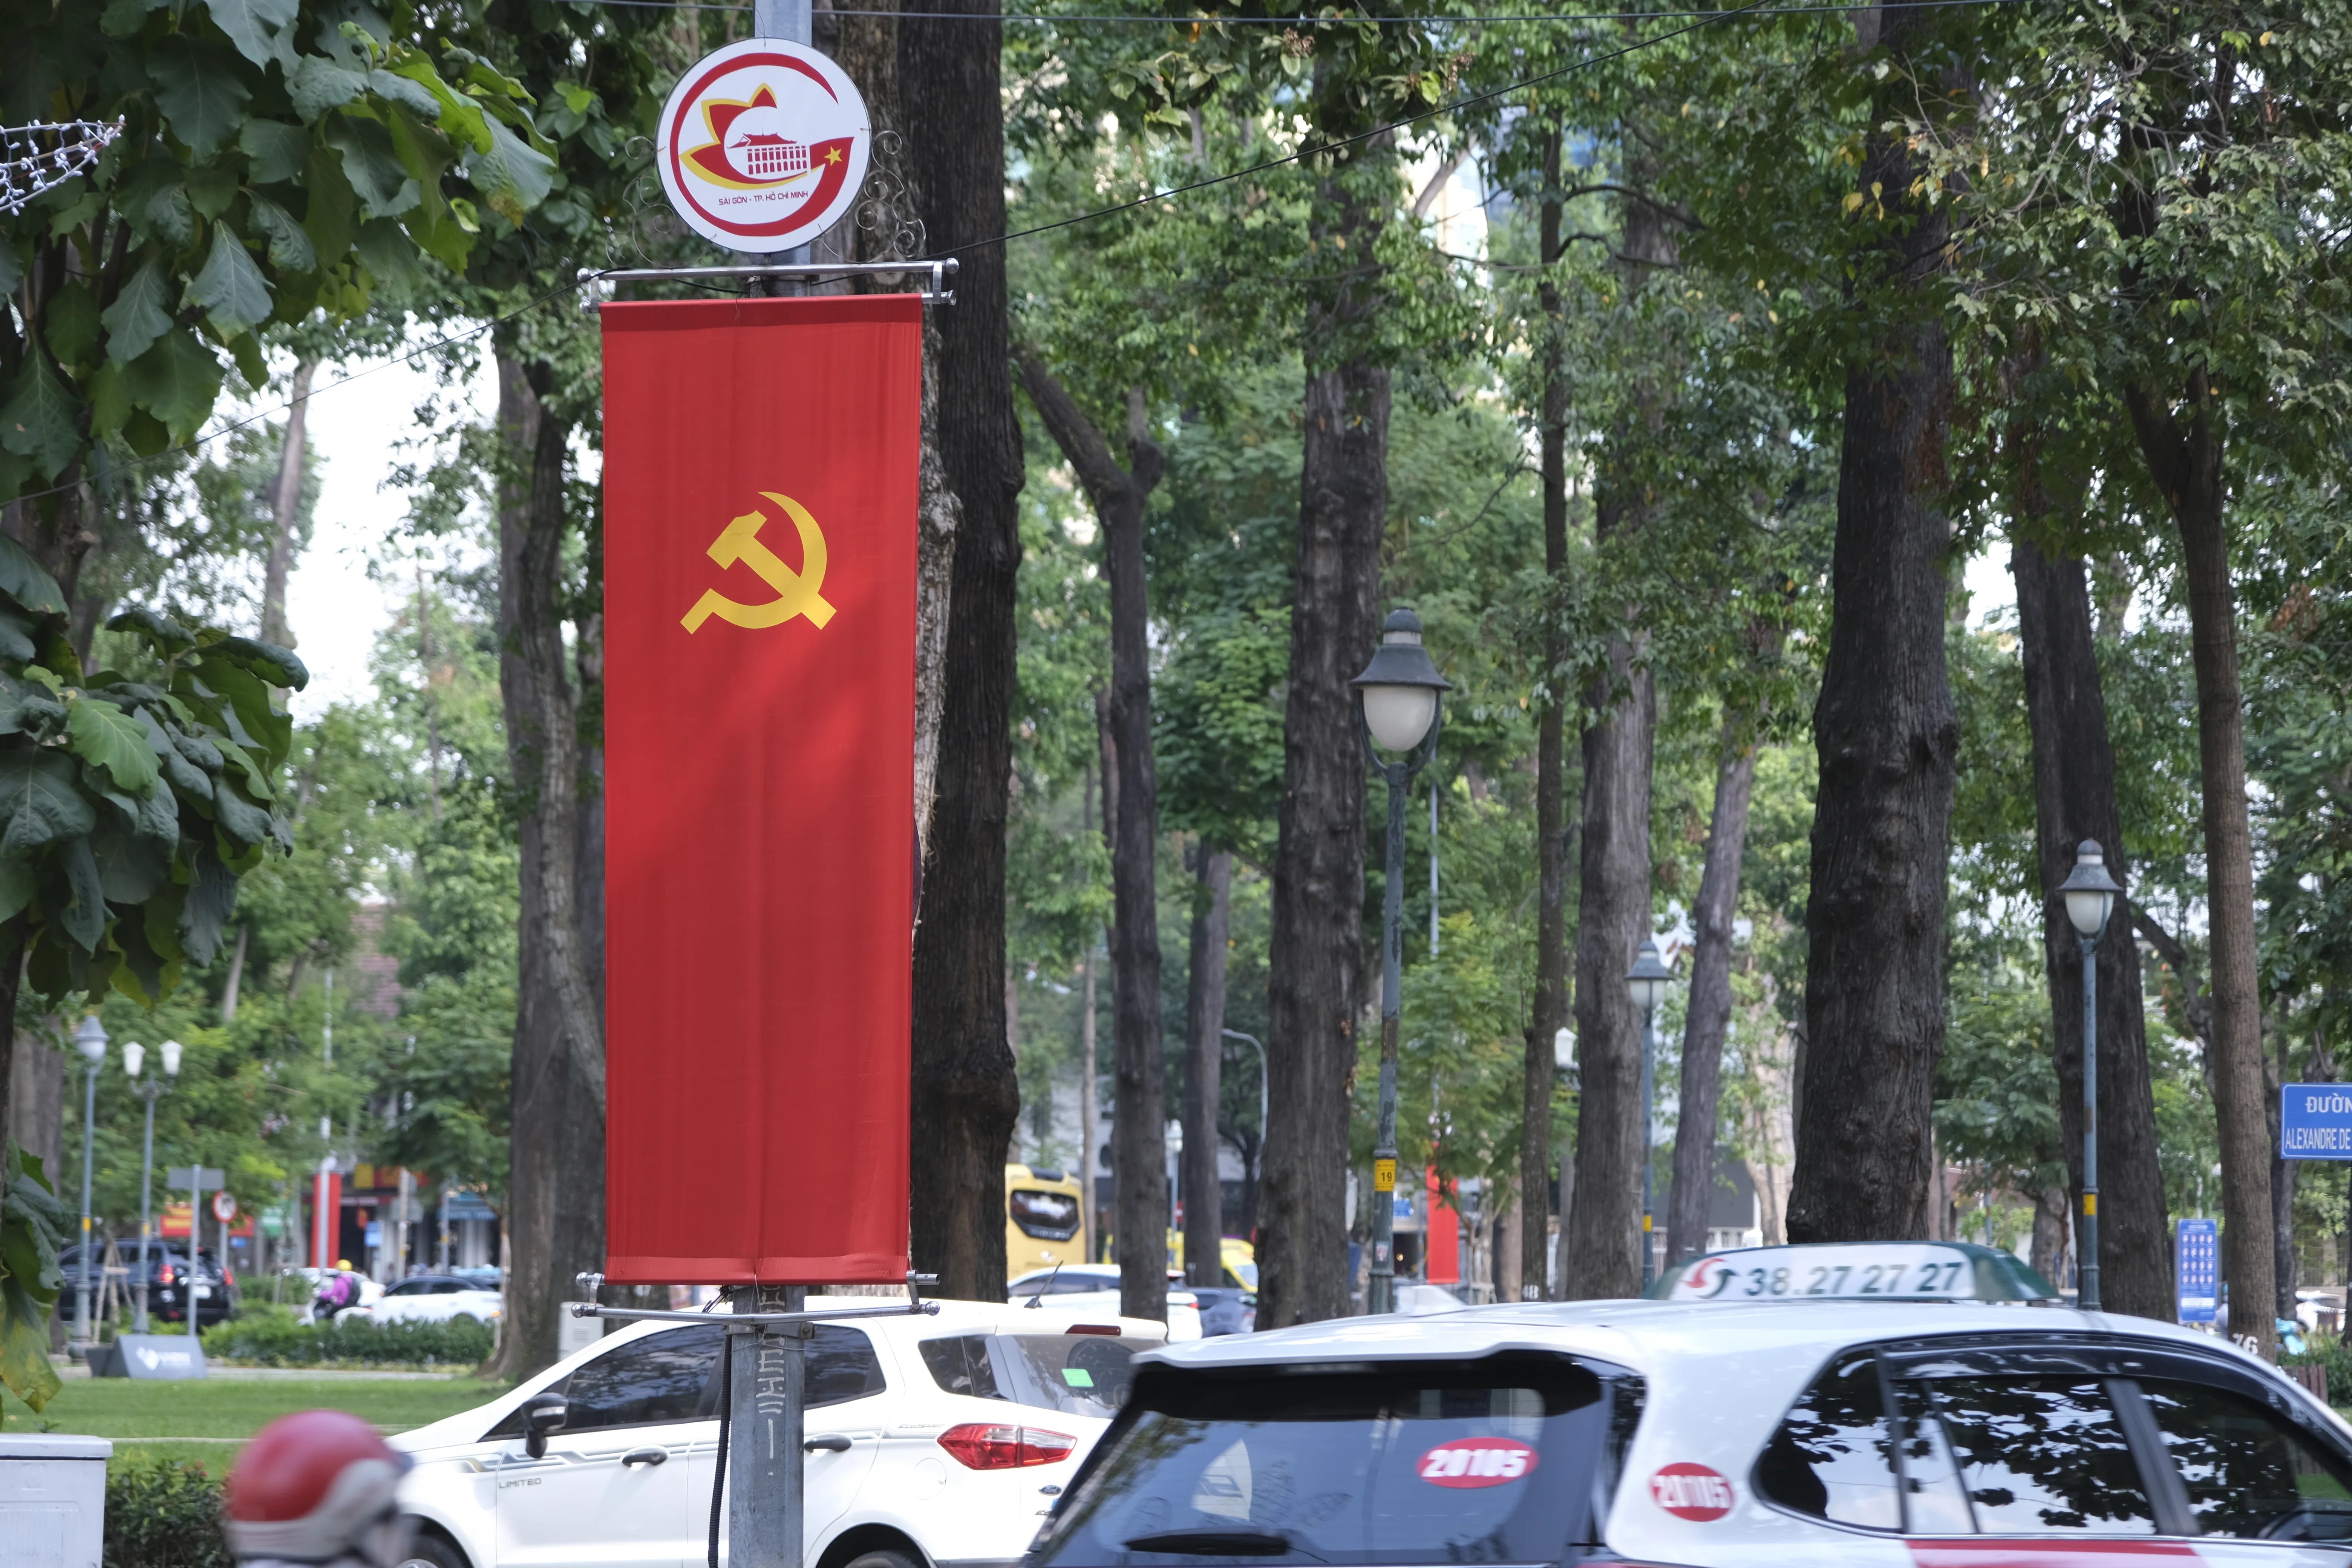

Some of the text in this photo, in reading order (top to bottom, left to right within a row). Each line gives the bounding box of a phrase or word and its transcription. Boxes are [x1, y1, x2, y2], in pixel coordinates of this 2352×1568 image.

[718, 197, 730, 205] SÀI
[732, 195, 747, 204] GÒN
[778, 191, 789, 199] CHÍ
[2285, 1128, 2351, 1150] ALEXANDRE DE
[1381, 1171, 1392, 1182] 19
[1857, 1264, 1908, 1294] 27
[1915, 1261, 1965, 1292] 27
[1421, 1449, 1530, 1477] 20105
[499, 1478, 542, 1488] LIMITED
[1652, 1475, 1730, 1508] 20105
